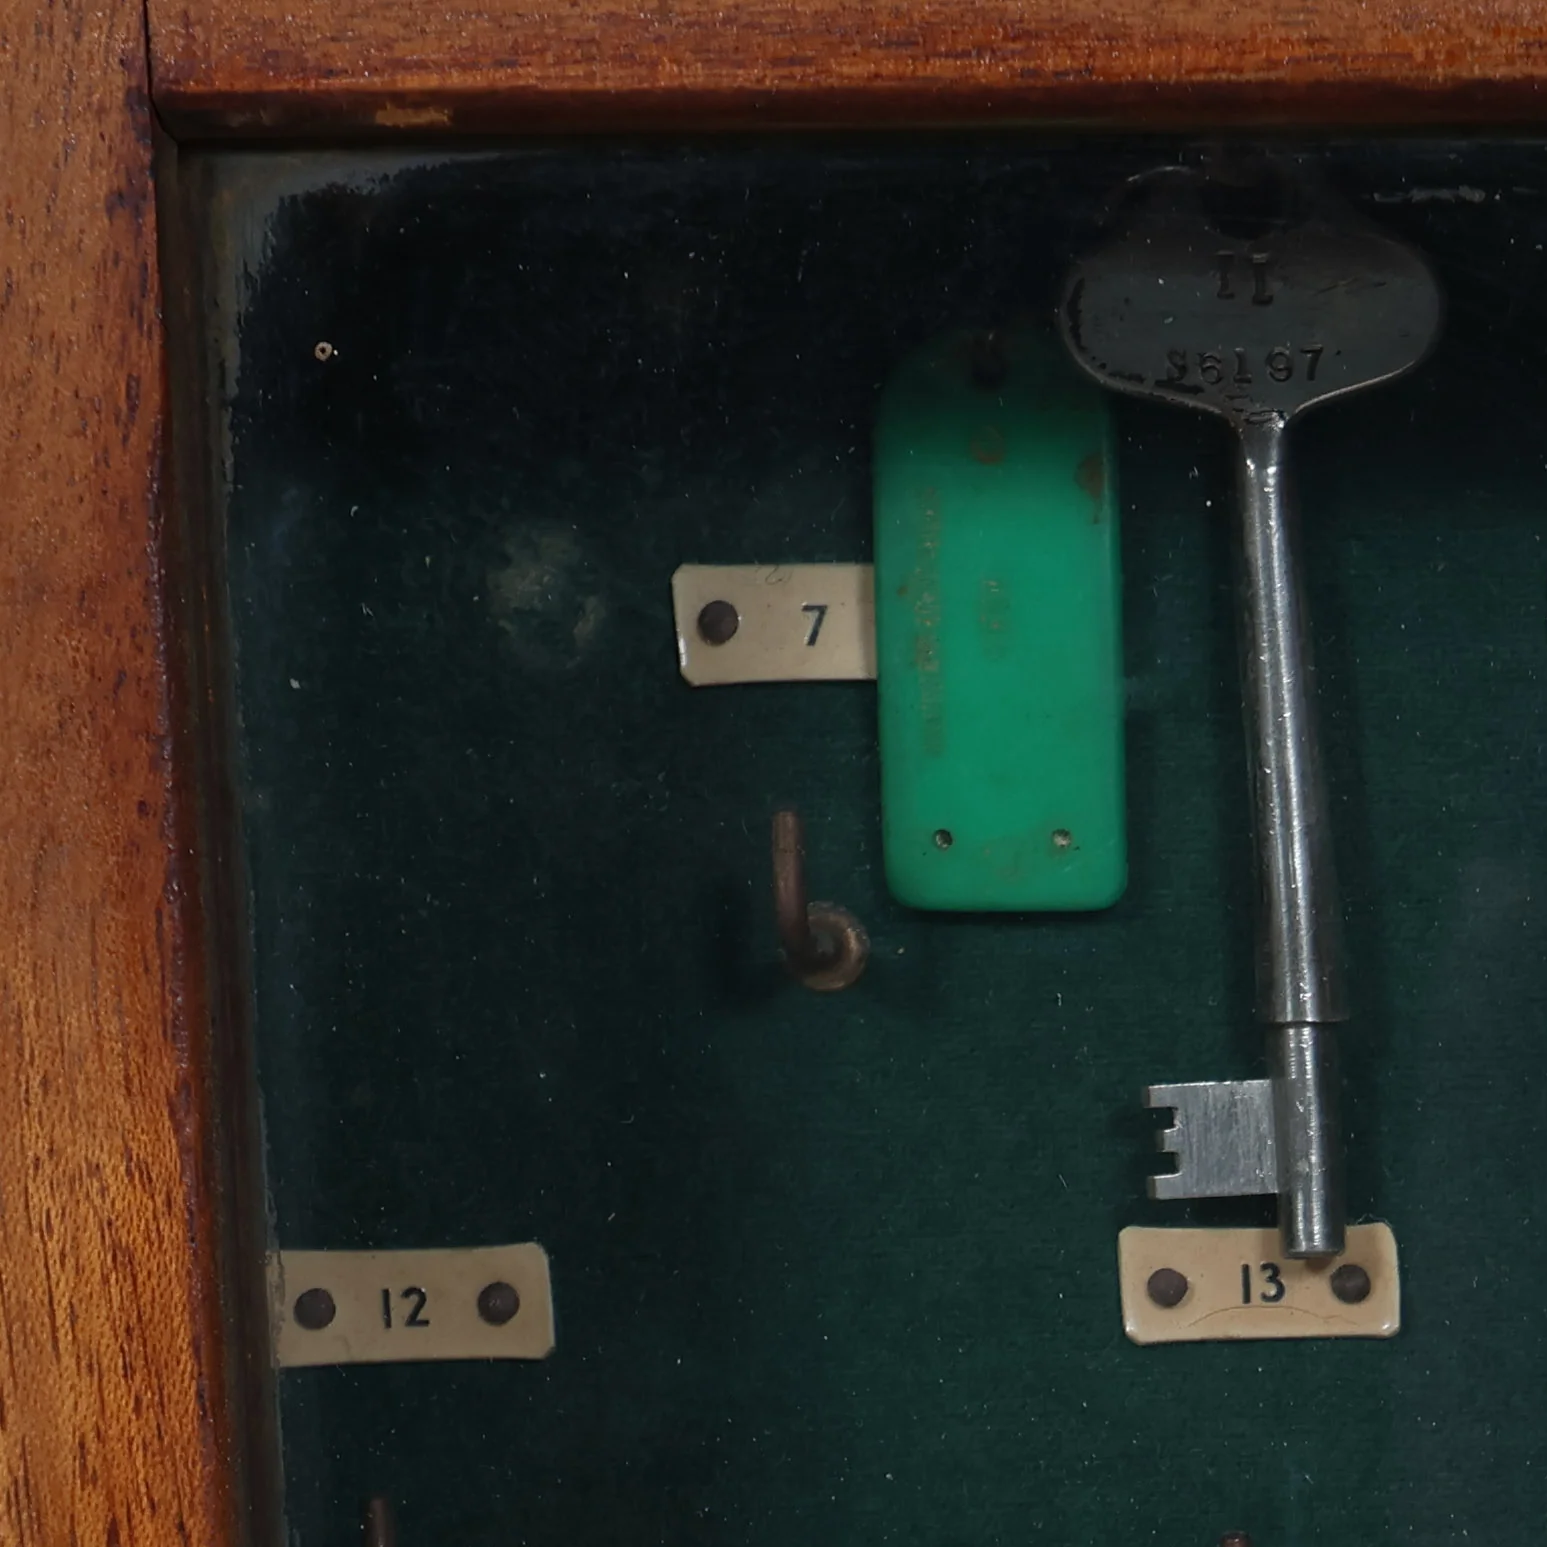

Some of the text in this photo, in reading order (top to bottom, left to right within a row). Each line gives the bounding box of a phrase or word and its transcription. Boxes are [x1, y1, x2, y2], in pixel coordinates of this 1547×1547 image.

[800, 603, 829, 648] 7
[1239, 1260, 1289, 1307] 13
[380, 1285, 431, 1330] 12
